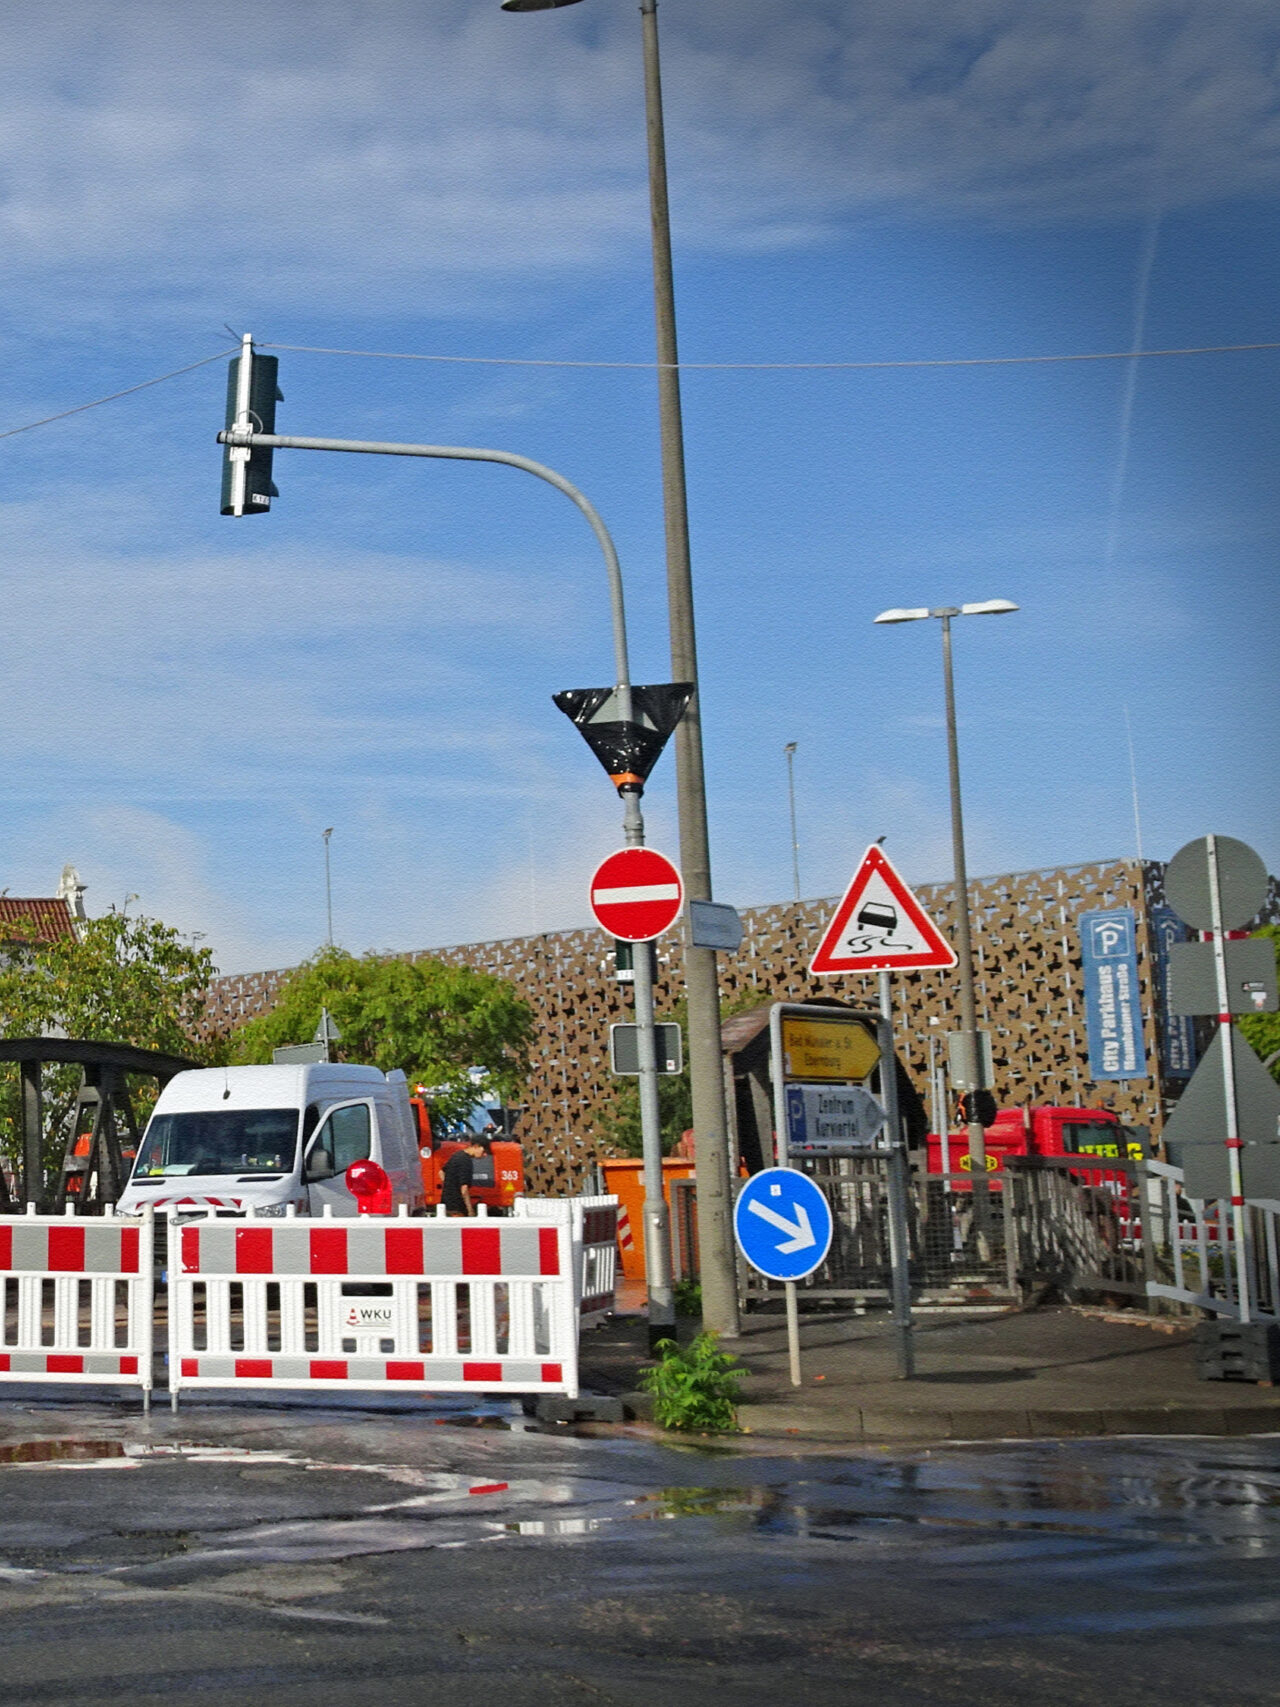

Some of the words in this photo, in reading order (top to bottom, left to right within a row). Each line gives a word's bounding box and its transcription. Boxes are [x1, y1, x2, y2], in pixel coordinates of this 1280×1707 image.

[1116, 963, 1130, 1001] Straße
[1098, 965, 1118, 1038] Parkhaus
[1121, 1002, 1136, 1071] Mannheimer
[1103, 1041, 1120, 1072] City
[818, 1093, 855, 1115] Zentrum
[815, 1116, 860, 1138] Kurviertel
[501, 1169, 520, 1181] 363
[360, 1309, 391, 1319] WKU
